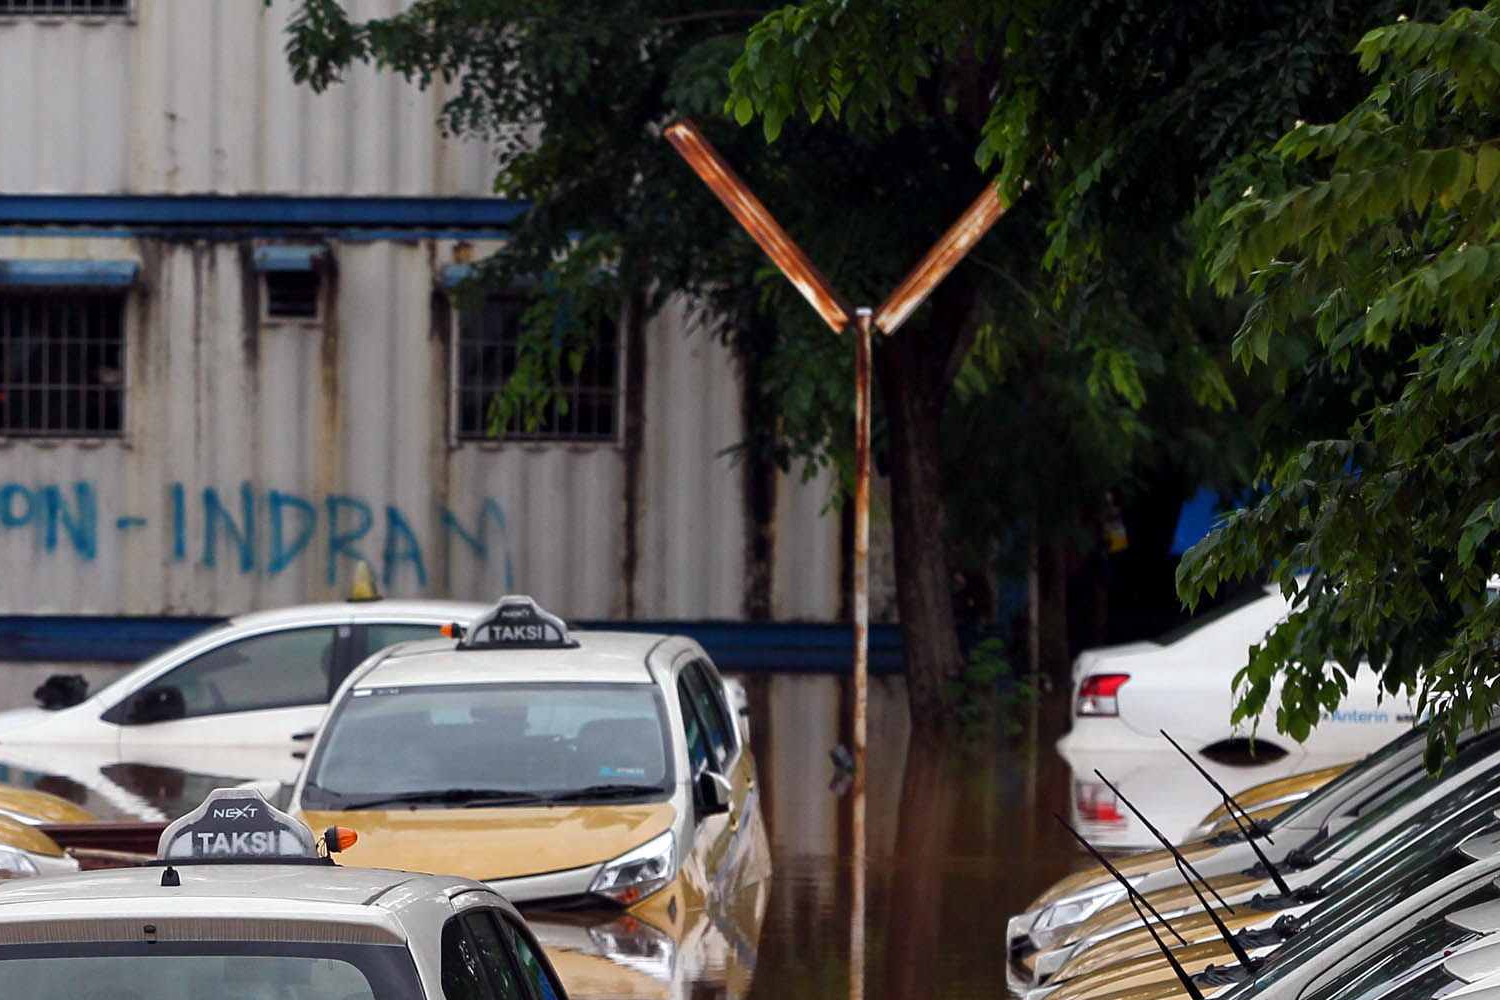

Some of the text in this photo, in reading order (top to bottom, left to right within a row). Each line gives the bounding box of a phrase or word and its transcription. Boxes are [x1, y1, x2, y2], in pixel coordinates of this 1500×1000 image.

[493, 625, 542, 640] TAKSI
[213, 803, 258, 820] NEXT
[197, 830, 276, 854] TAKSI
